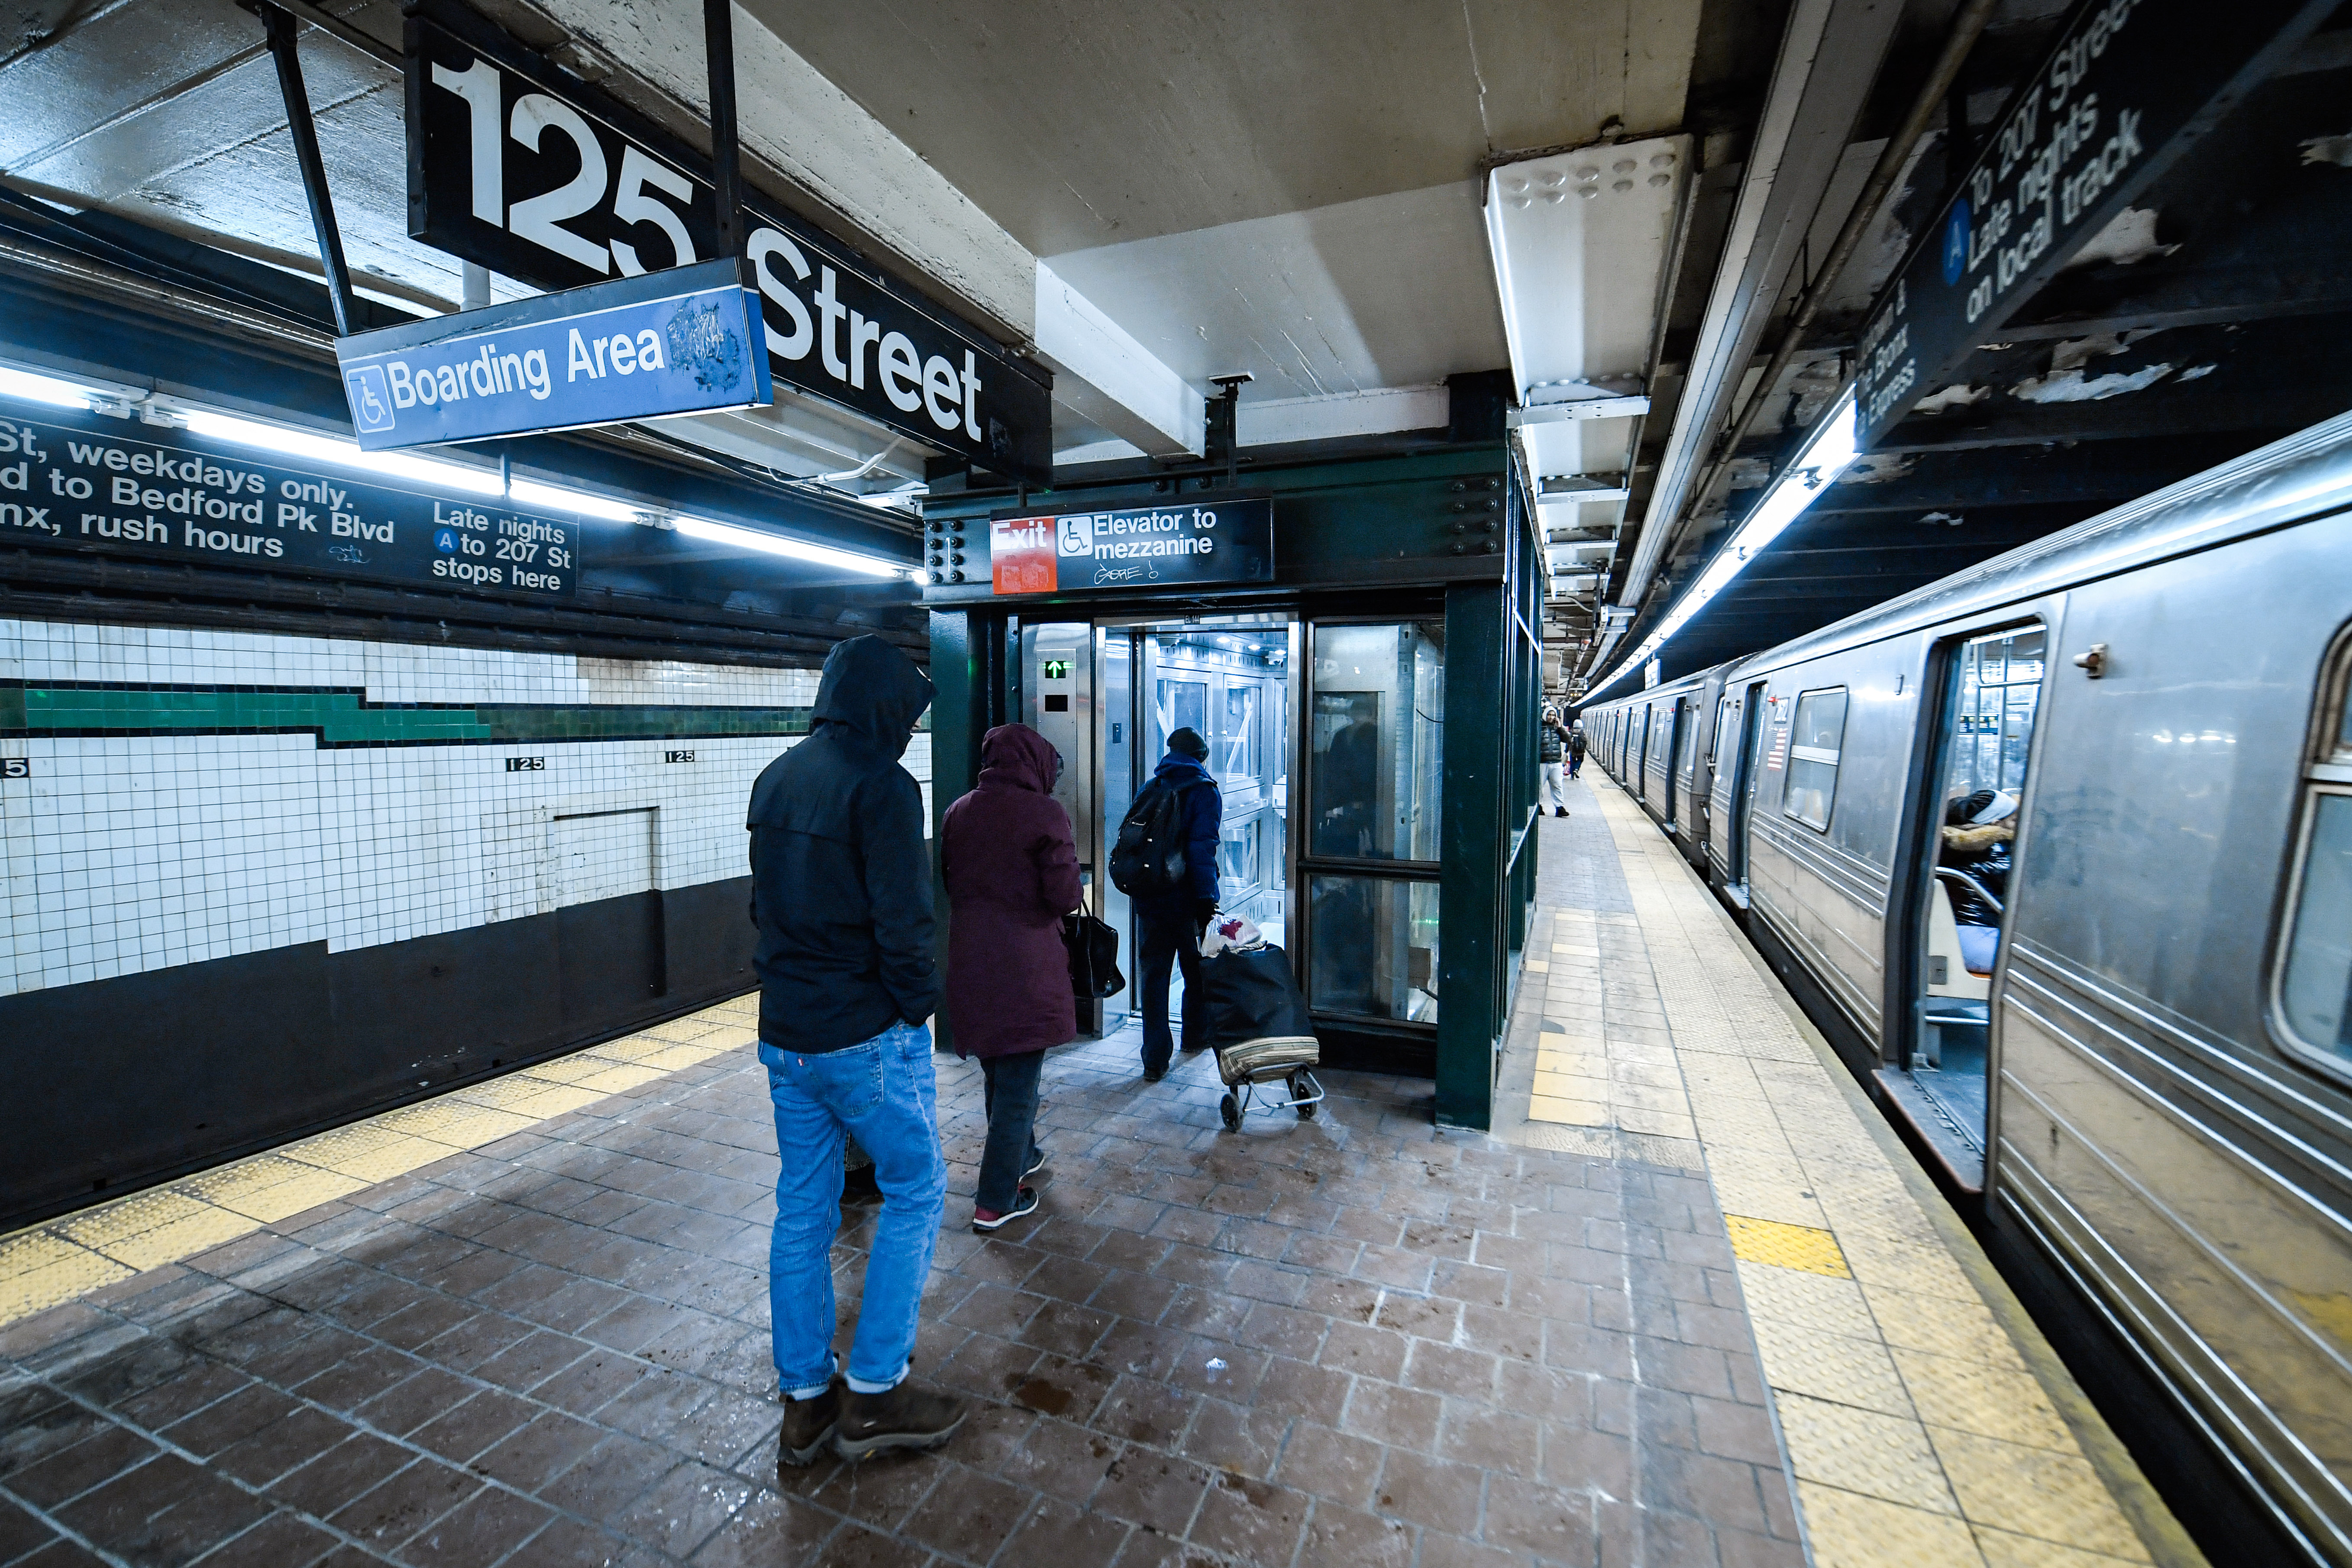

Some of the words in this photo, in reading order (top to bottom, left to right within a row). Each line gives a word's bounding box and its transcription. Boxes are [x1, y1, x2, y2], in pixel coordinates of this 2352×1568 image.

[1997, 83, 2043, 183] 207
[2048, 0, 2143, 113] Stree
[1967, 198, 2013, 274] Late
[2017, 92, 2100, 215] nights
[1967, 274, 1992, 324] on
[1997, 193, 2053, 294] local
[2061, 107, 2144, 226] track
[432, 58, 696, 277] 125
[746, 227, 982, 443] Street
[388, 343, 551, 409] Boarding
[567, 327, 666, 382] Area
[0, 420, 47, 463] St,
[68, 441, 265, 494] weekdays
[281, 480, 353, 511] only.
[48, 468, 93, 499] to
[112, 476, 263, 524] Bedford
[278, 503, 318, 533] Pk
[331, 511, 394, 543] Blvd
[434, 501, 488, 531] Late
[499, 516, 565, 544] nights
[1094, 511, 1183, 536] Elevator
[1192, 508, 1217, 529] to
[81, 513, 168, 543] rush
[185, 521, 284, 558] hours
[439, 533, 453, 549] A
[460, 533, 485, 556] to
[495, 538, 539, 563] 207
[547, 546, 571, 569] St
[992, 520, 1047, 551] Exit
[1095, 533, 1213, 560] mezzanine
[433, 557, 502, 585] stops
[512, 565, 561, 591] here
[510, 757, 543, 771] 125
[669, 751, 694, 762] 125
